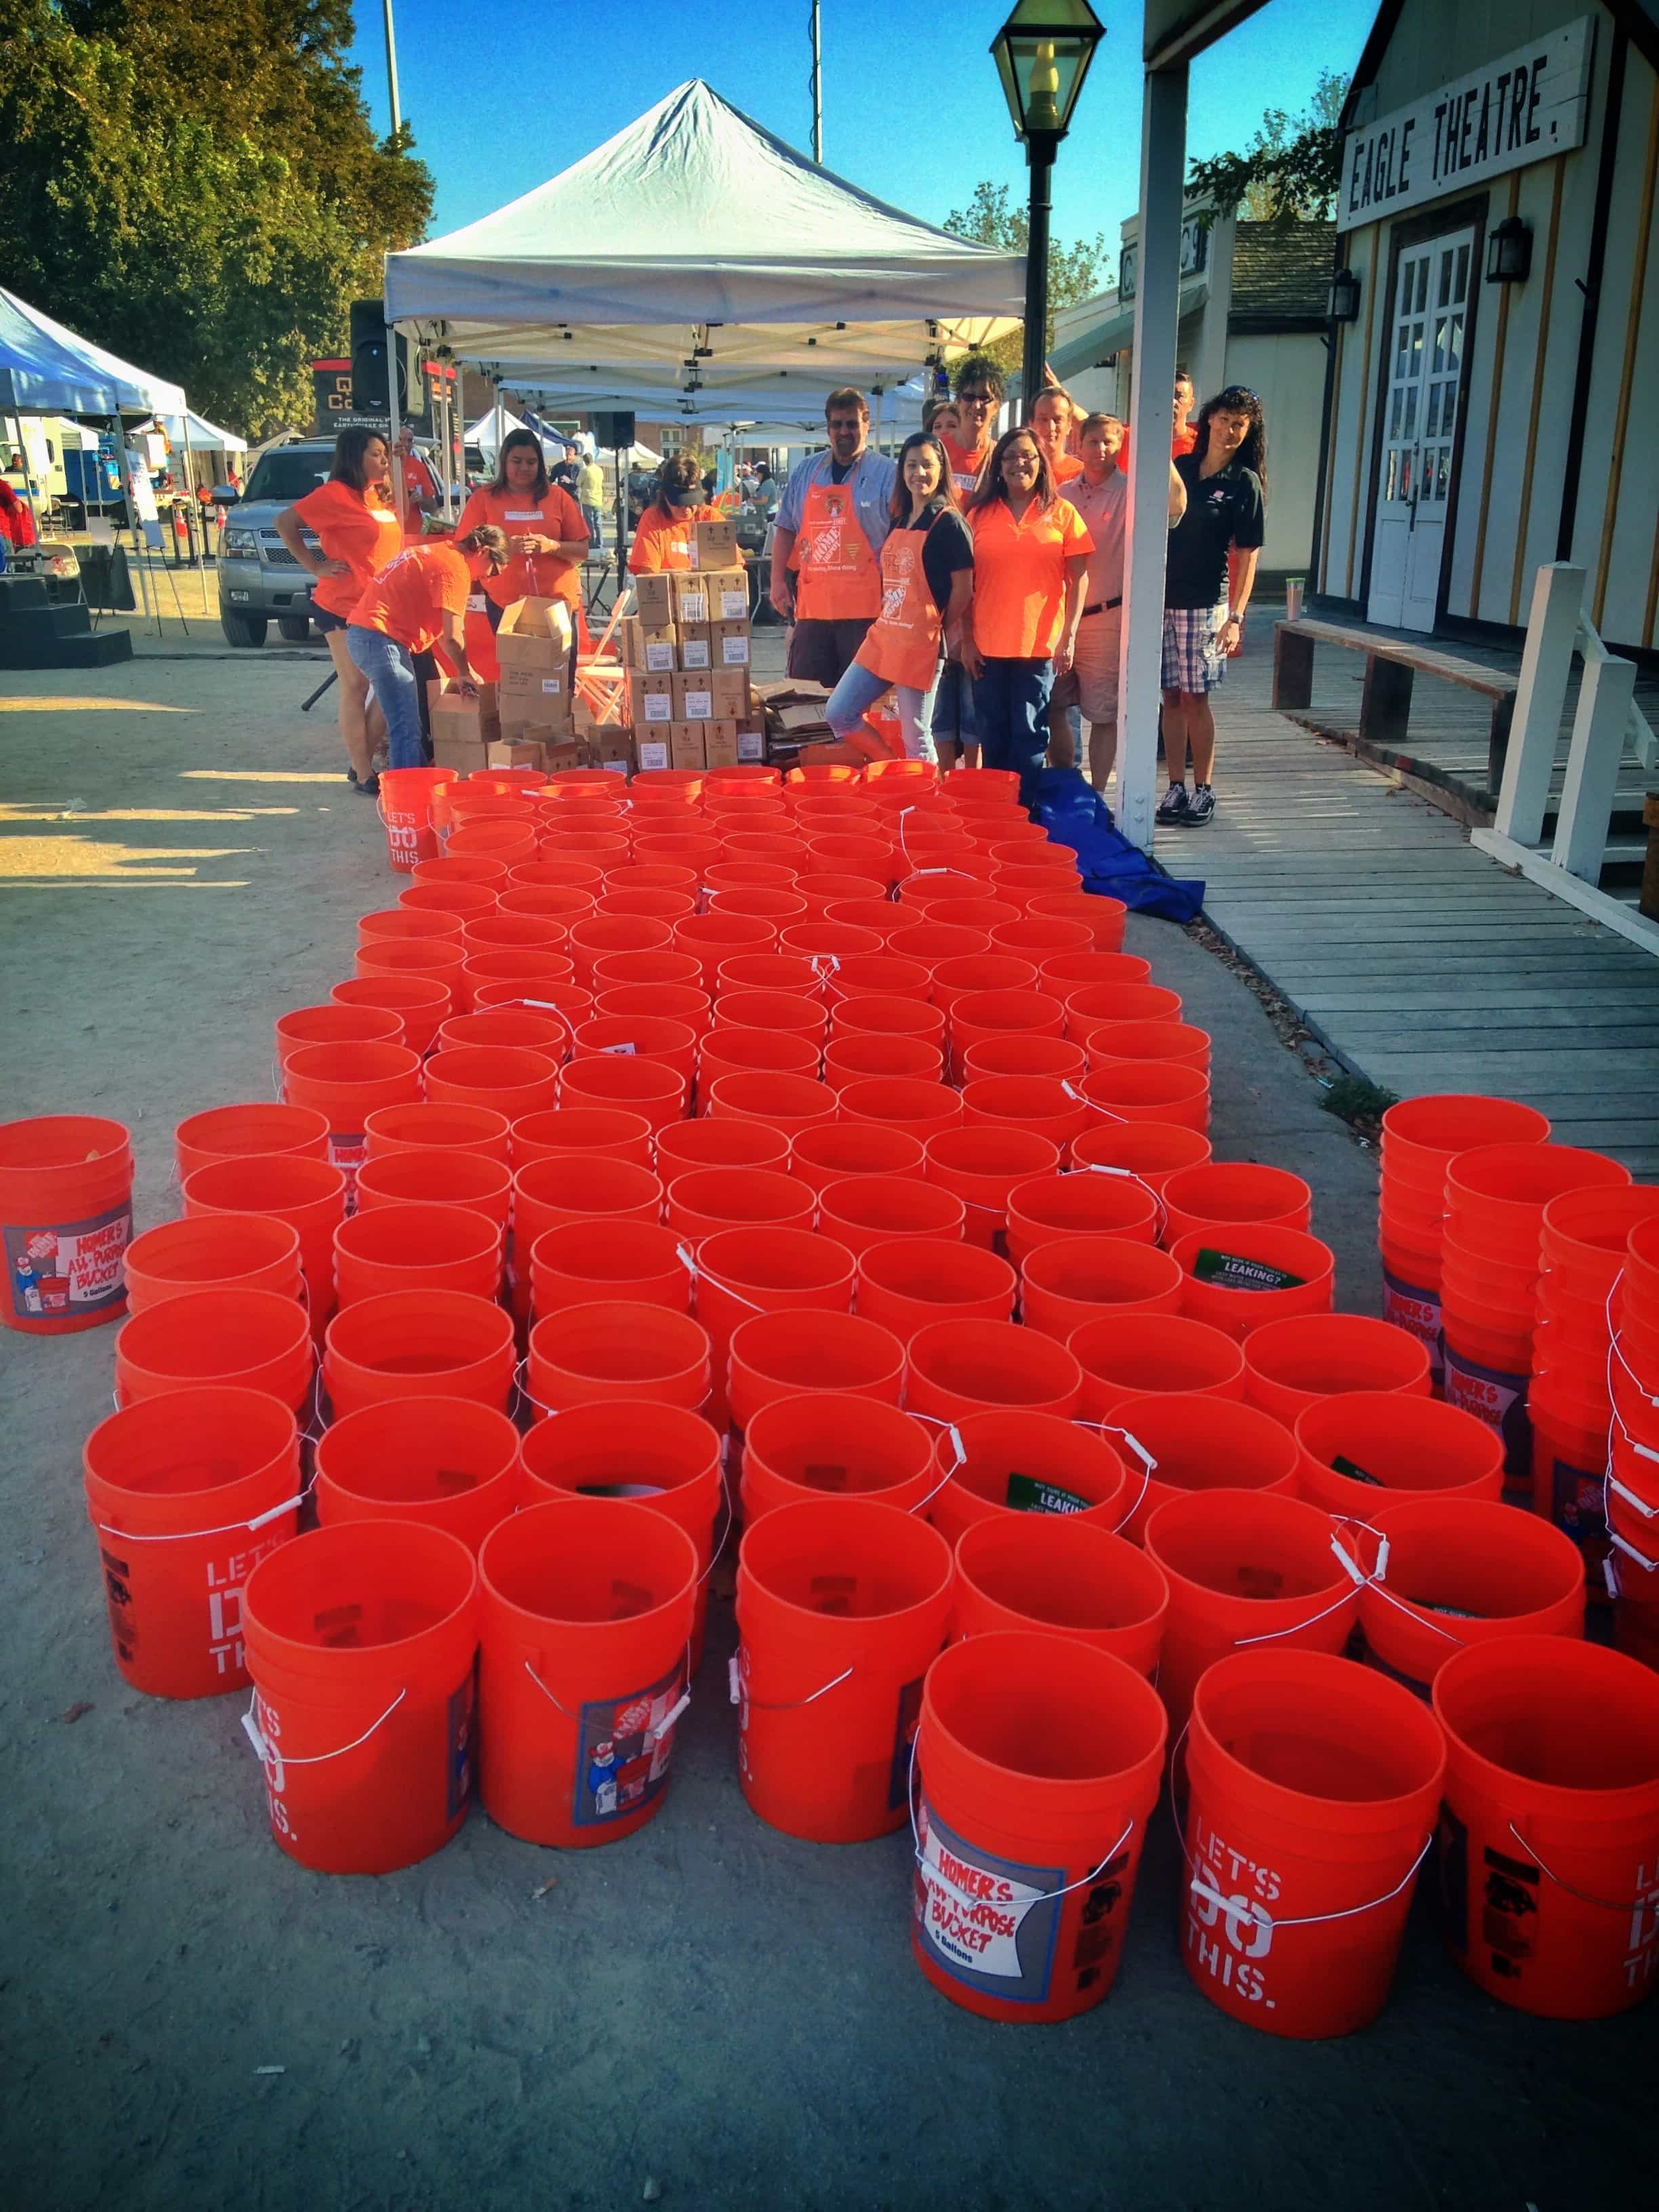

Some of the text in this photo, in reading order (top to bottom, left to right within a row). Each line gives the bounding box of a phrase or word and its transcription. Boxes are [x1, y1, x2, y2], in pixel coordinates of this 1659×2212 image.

[1349, 118, 1415, 213] EAGLE
[387, 810, 416, 824] LET'S
[390, 824, 417, 848] DO
[76, 1222, 123, 1256] HOMER'S
[77, 1261, 119, 1290] BUCKET
[1225, 1261, 1282, 1286] LEAKING?
[1041, 1492, 1084, 1514] LEAKIN
[1197, 1816, 1282, 1900] LET'S
[938, 1848, 1014, 1907] HOMER'S
[1191, 1853, 1273, 1958] DO
[932, 1899, 993, 1954] BUCKET
[941, 1933, 973, 1963] Gallons
[1187, 1911, 1275, 2009] THIS.
